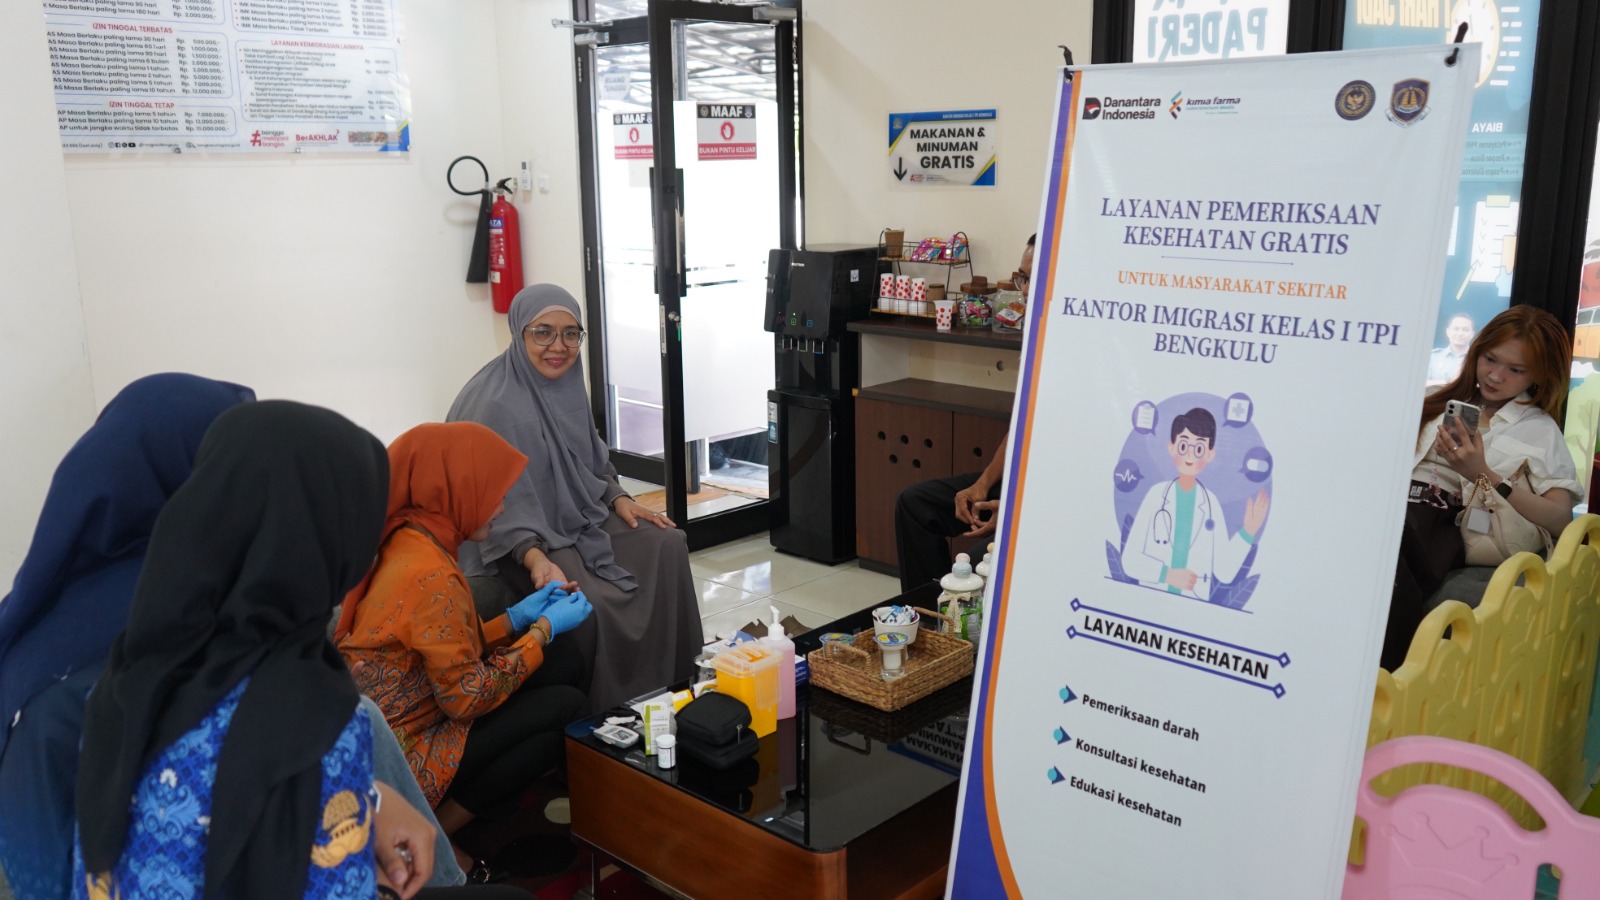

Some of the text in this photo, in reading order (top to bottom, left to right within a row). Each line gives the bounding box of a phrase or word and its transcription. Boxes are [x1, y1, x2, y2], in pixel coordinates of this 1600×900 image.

[711, 106, 742, 117] MAAF
[1102, 109, 1155, 120] Indonesia
[1104, 97, 1161, 107] Danantara
[622, 114, 645, 123] MAAF
[910, 127, 985, 139] MAKANAN &
[917, 141, 978, 152] MINUMAN
[921, 156, 974, 168] GRATIS
[1100, 198, 1381, 225] LAYANAN PEMERIKSAAN
[1123, 226, 1349, 255] KESEHATAN GRATIS
[1118, 270, 1347, 299] UNTUK MASYARAKAT SEKITAR
[1062, 297, 1400, 345] KANTOR IMIGRASI KELAS I TPI
[1153, 332, 1278, 364] BENGKULU
[1084, 615, 1269, 680] LAYANAN KESEHATAN
[1082, 694, 1199, 741] Pemeriksaan darah
[1076, 738, 1206, 794] Konsultasi kesehatan
[1070, 776, 1182, 827] Edukasi kesehatan
